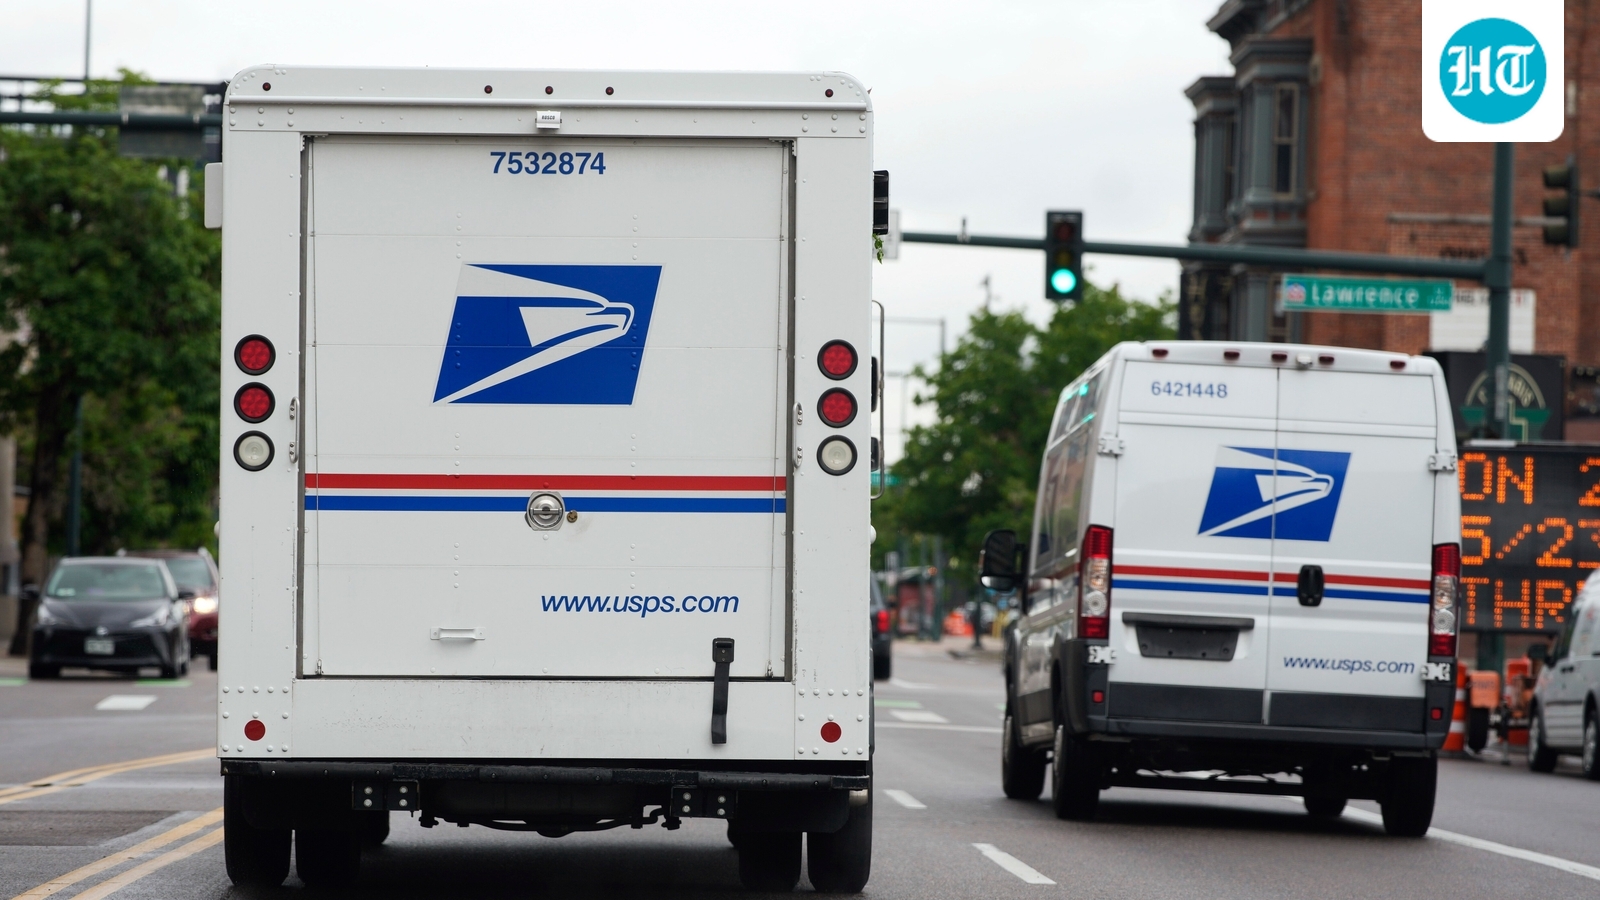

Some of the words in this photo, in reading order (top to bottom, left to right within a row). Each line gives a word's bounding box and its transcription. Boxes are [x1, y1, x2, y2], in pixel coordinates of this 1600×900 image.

[490, 151, 606, 174] 7532874
[1311, 281, 1420, 307] Lawrence
[1151, 381, 1228, 398] 6421448
[541, 595, 740, 618] www.usps.com
[1461, 577, 1586, 629] THR
[1283, 657, 1415, 674] www.usps.com
